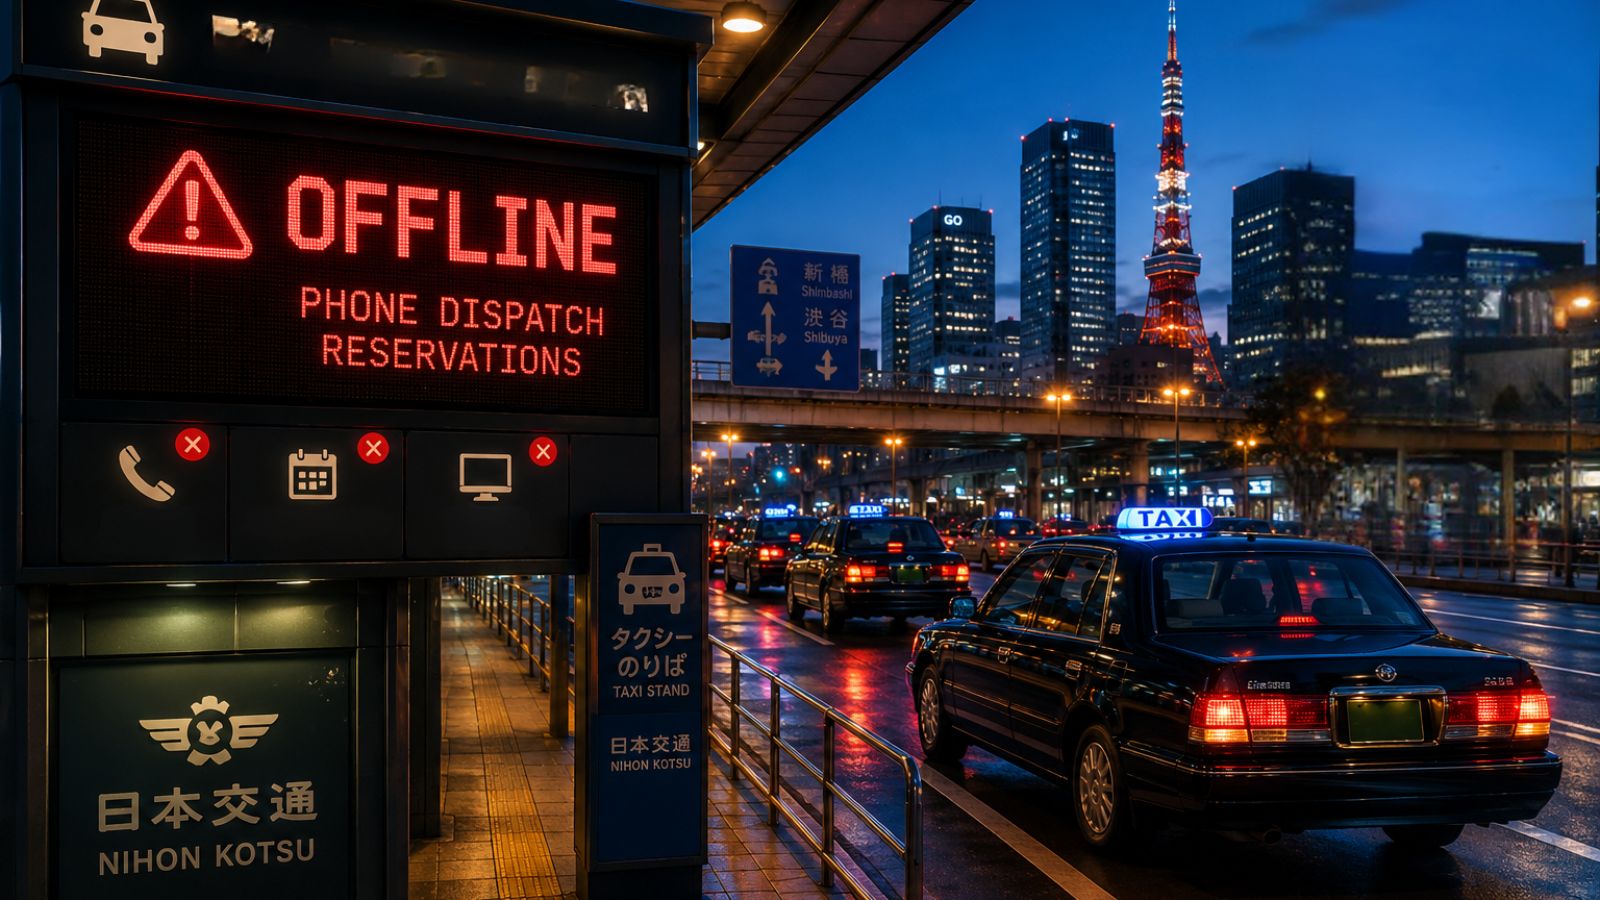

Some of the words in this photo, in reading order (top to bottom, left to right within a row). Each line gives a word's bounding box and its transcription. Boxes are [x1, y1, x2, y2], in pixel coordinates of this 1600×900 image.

[287, 175, 616, 274] OFFLINE
[943, 214, 963, 226] GO
[301, 286, 417, 325] PHONE
[440, 297, 603, 336] DISPATCH
[804, 331, 848, 346] Shibuya
[322, 334, 581, 377] RESERVATIONS
[1137, 509, 1197, 527] TAXI
[611, 627, 693, 650] タクシー
[613, 685, 643, 698] TAXI
[647, 684, 690, 697] STAND
[611, 734, 692, 754] 日本交通
[611, 760, 649, 772] NIHON
[653, 758, 691, 770] KOTSU
[98, 780, 318, 832] 日本交通
[100, 846, 200, 875] NIHON
[215, 838, 315, 868] KOTSU
